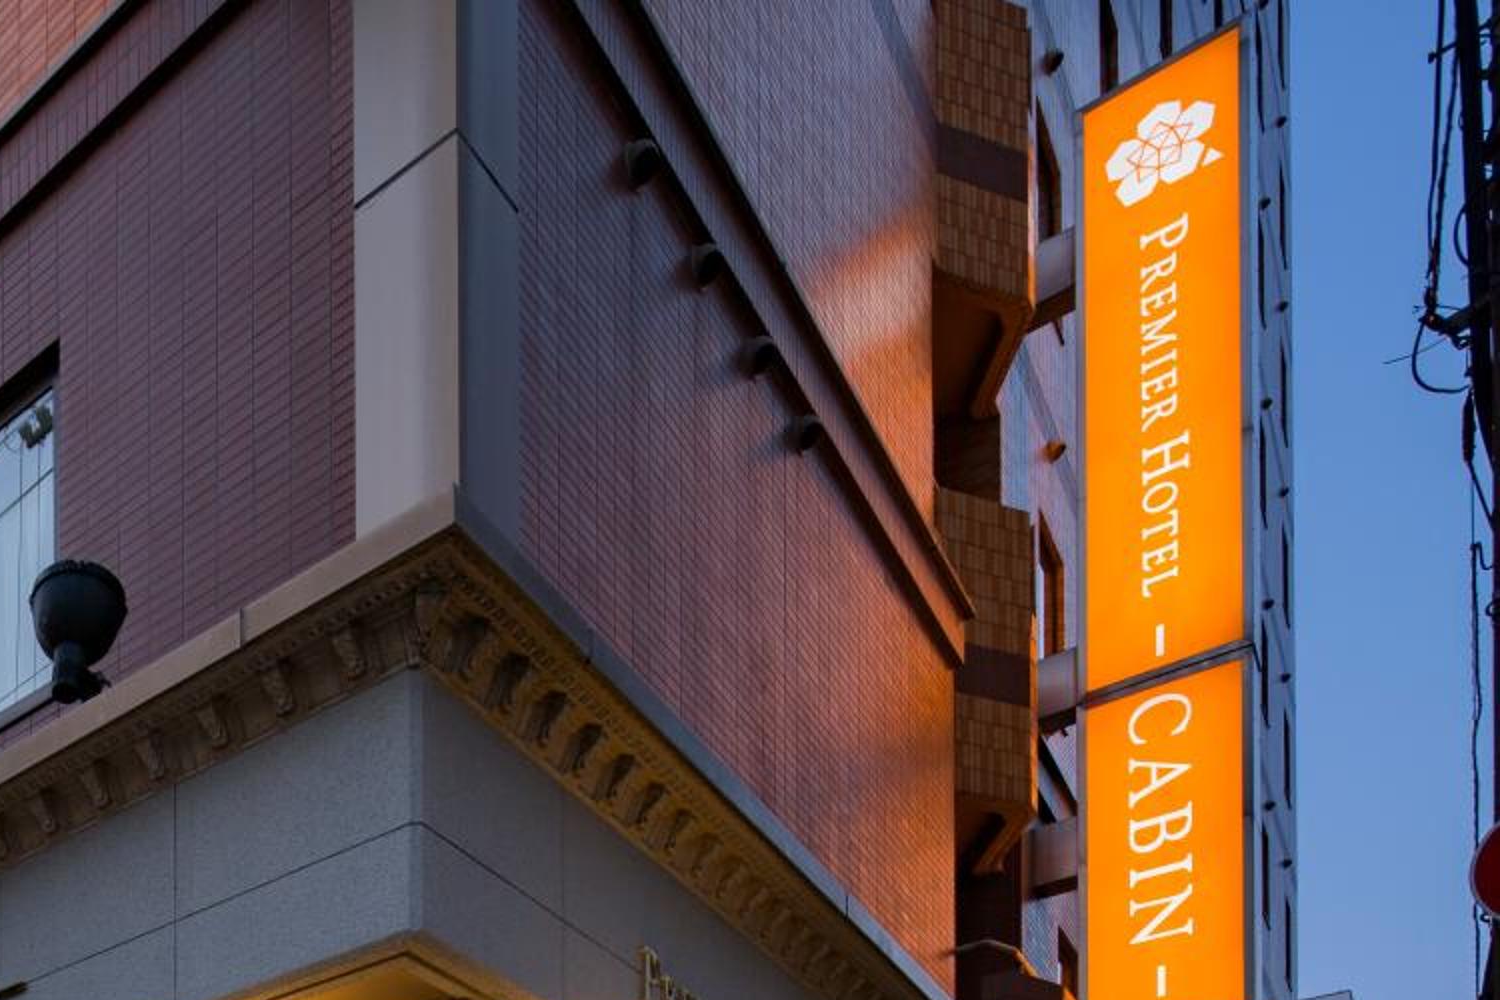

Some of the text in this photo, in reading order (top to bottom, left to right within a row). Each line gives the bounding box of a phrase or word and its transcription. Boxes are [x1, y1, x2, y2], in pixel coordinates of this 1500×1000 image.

[1139, 213, 1189, 598] PREMIER HOTEL
[1127, 692, 1194, 946] CABIN
